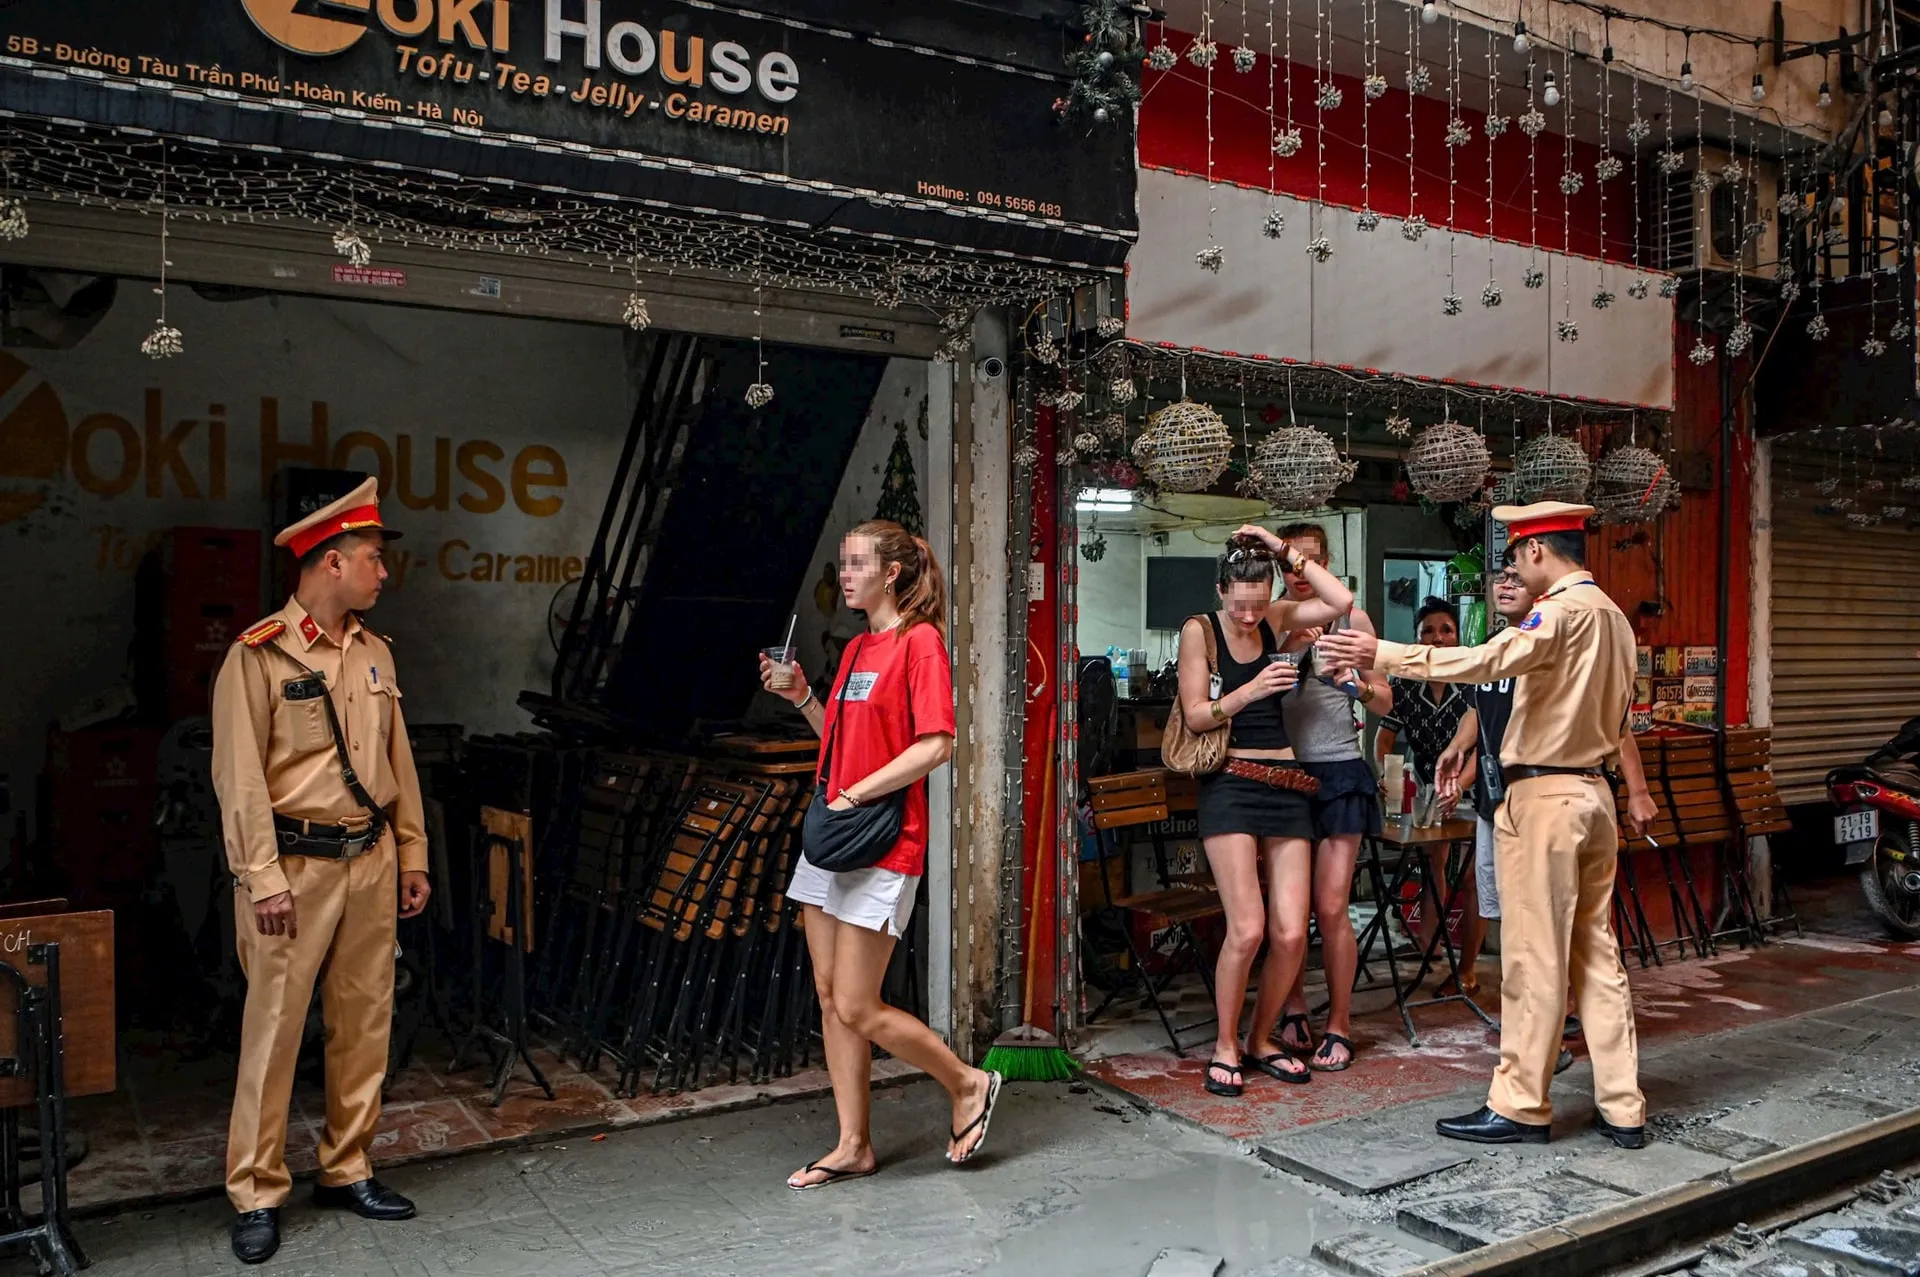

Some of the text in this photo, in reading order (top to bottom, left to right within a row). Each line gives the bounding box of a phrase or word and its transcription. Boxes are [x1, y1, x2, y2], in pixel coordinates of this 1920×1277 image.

[7, 35, 39, 55] 5B
[55, 43, 131, 75] Đường
[138, 56, 179, 77] Tàu
[185, 63, 235, 87] Trần
[241, 72, 280, 93] Phú
[294, 81, 346, 103] Hoàn
[352, 90, 402, 112] Kiếm
[418, 101, 442, 119] Hà
[453, 107, 484, 129] Nội
[397, 45, 474, 83] Tofu
[495, 62, 550, 96] Tea
[571, 77, 645, 118] Jelly
[664, 93, 790, 136] Caramen
[544, 0, 800, 102] House
[917, 181, 1062, 217] Hotline: 094 5656 483
[260, 397, 568, 517] House
[437, 539, 590, 583] Carame
[1841, 825, 1872, 841] 2419
